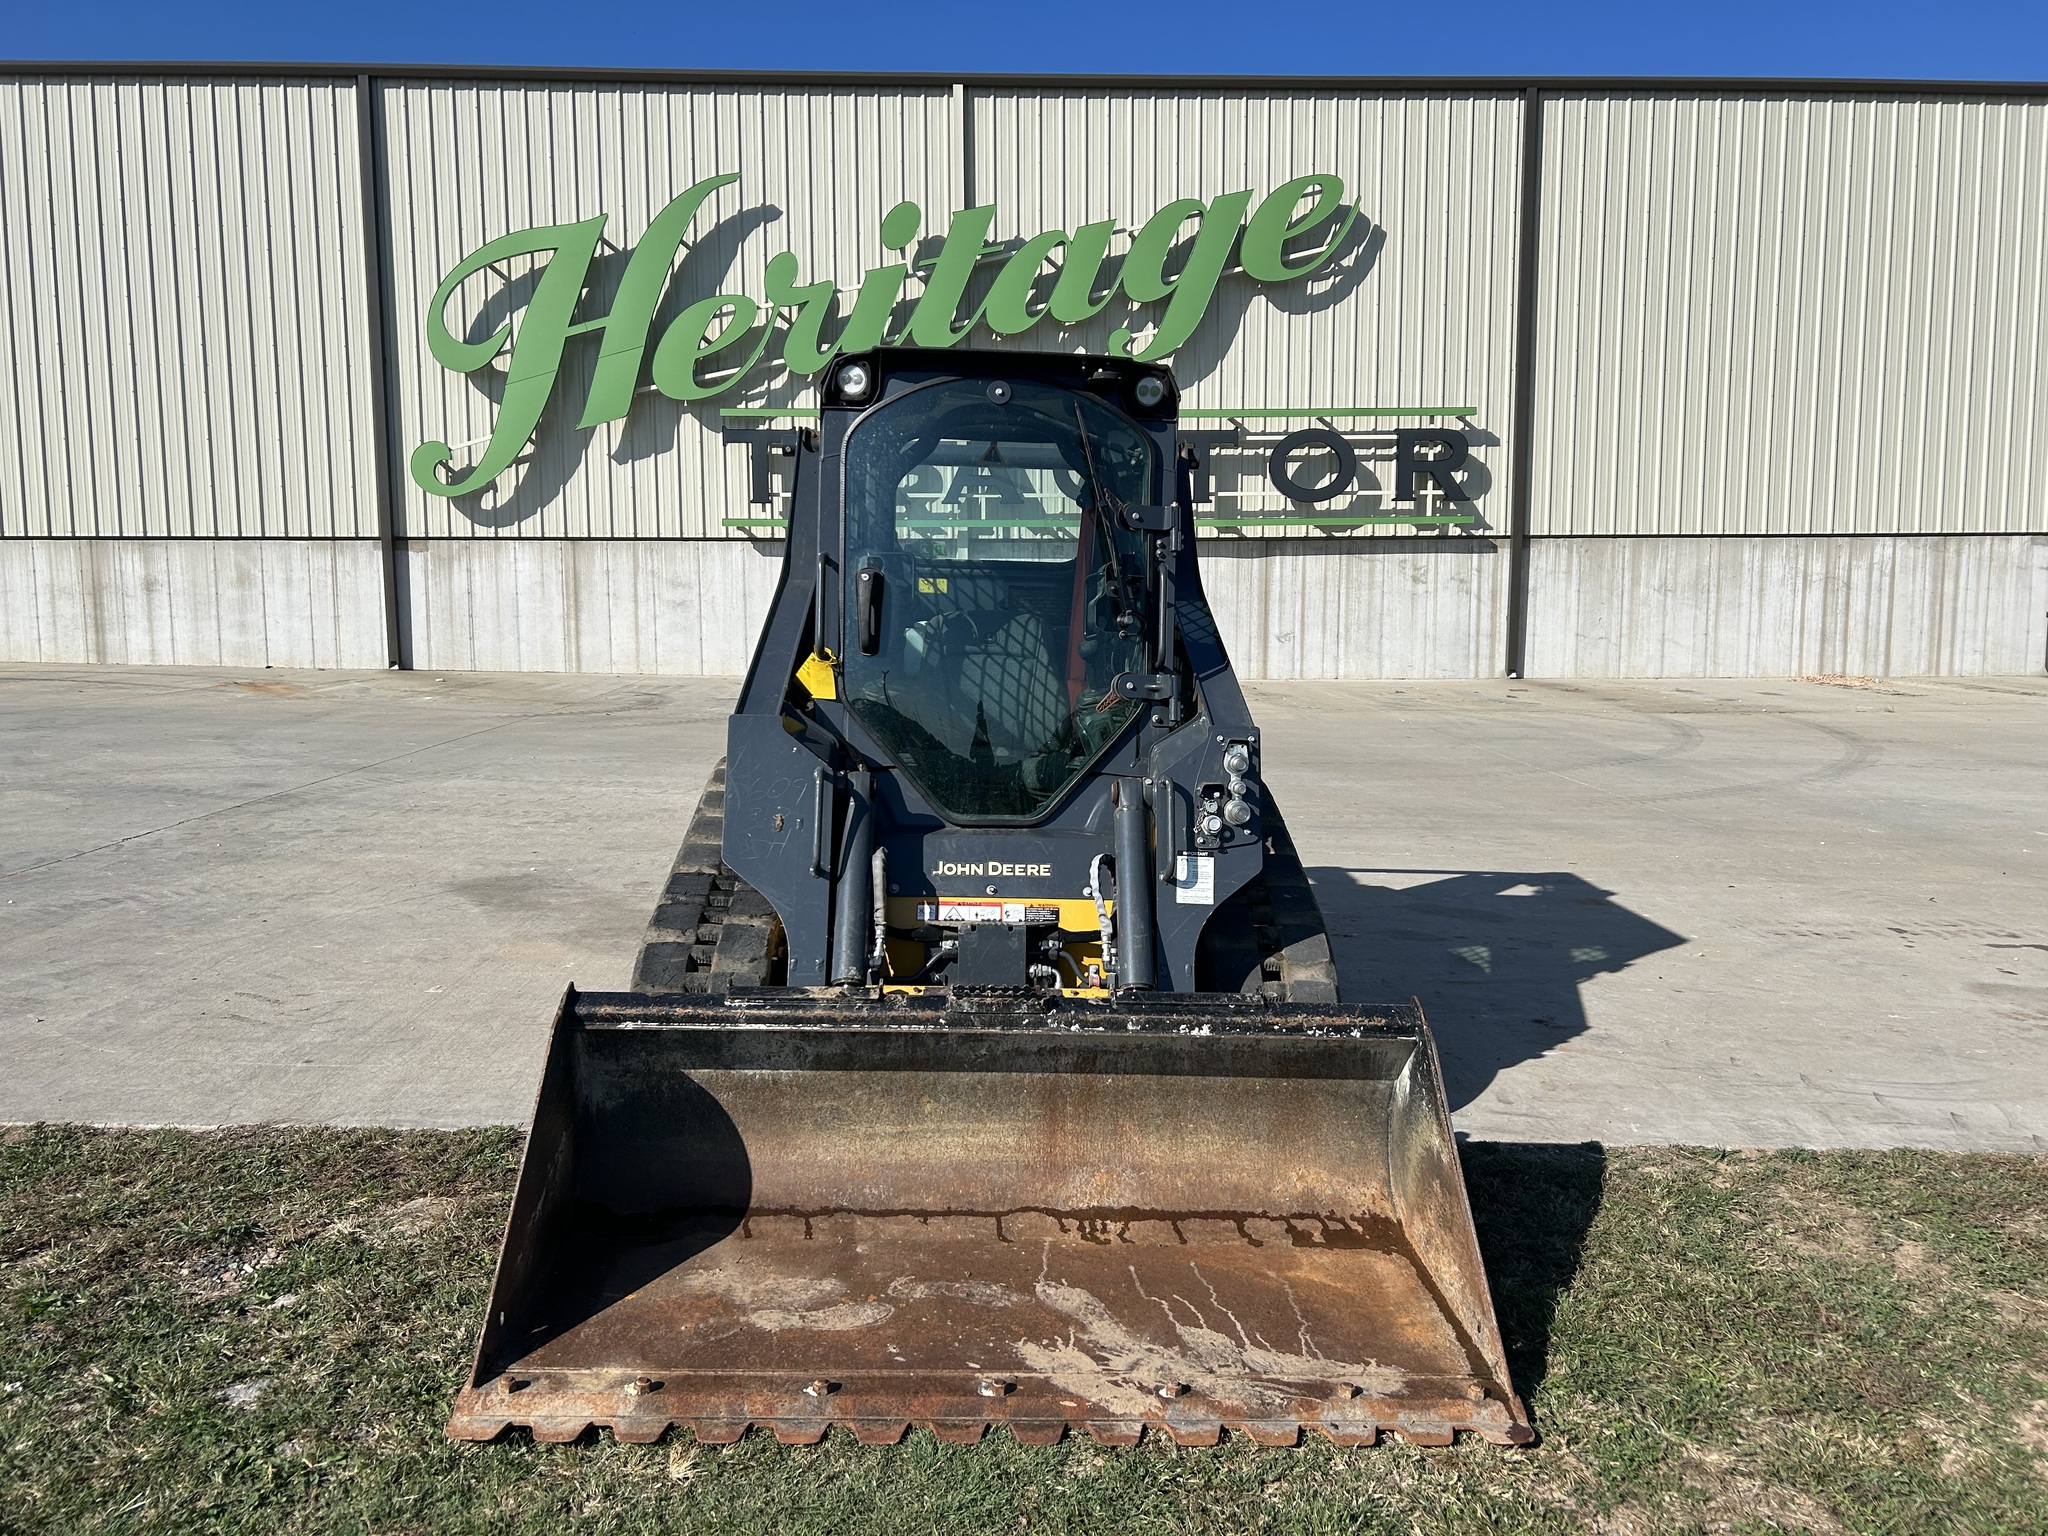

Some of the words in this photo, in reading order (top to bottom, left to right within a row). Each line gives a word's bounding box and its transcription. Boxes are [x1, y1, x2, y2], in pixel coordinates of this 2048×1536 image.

[411, 173, 1362, 498] Heritage
[722, 425, 1470, 503] TATOR
[932, 860, 984, 876] JOHN
[988, 861, 1052, 876] DEERE
